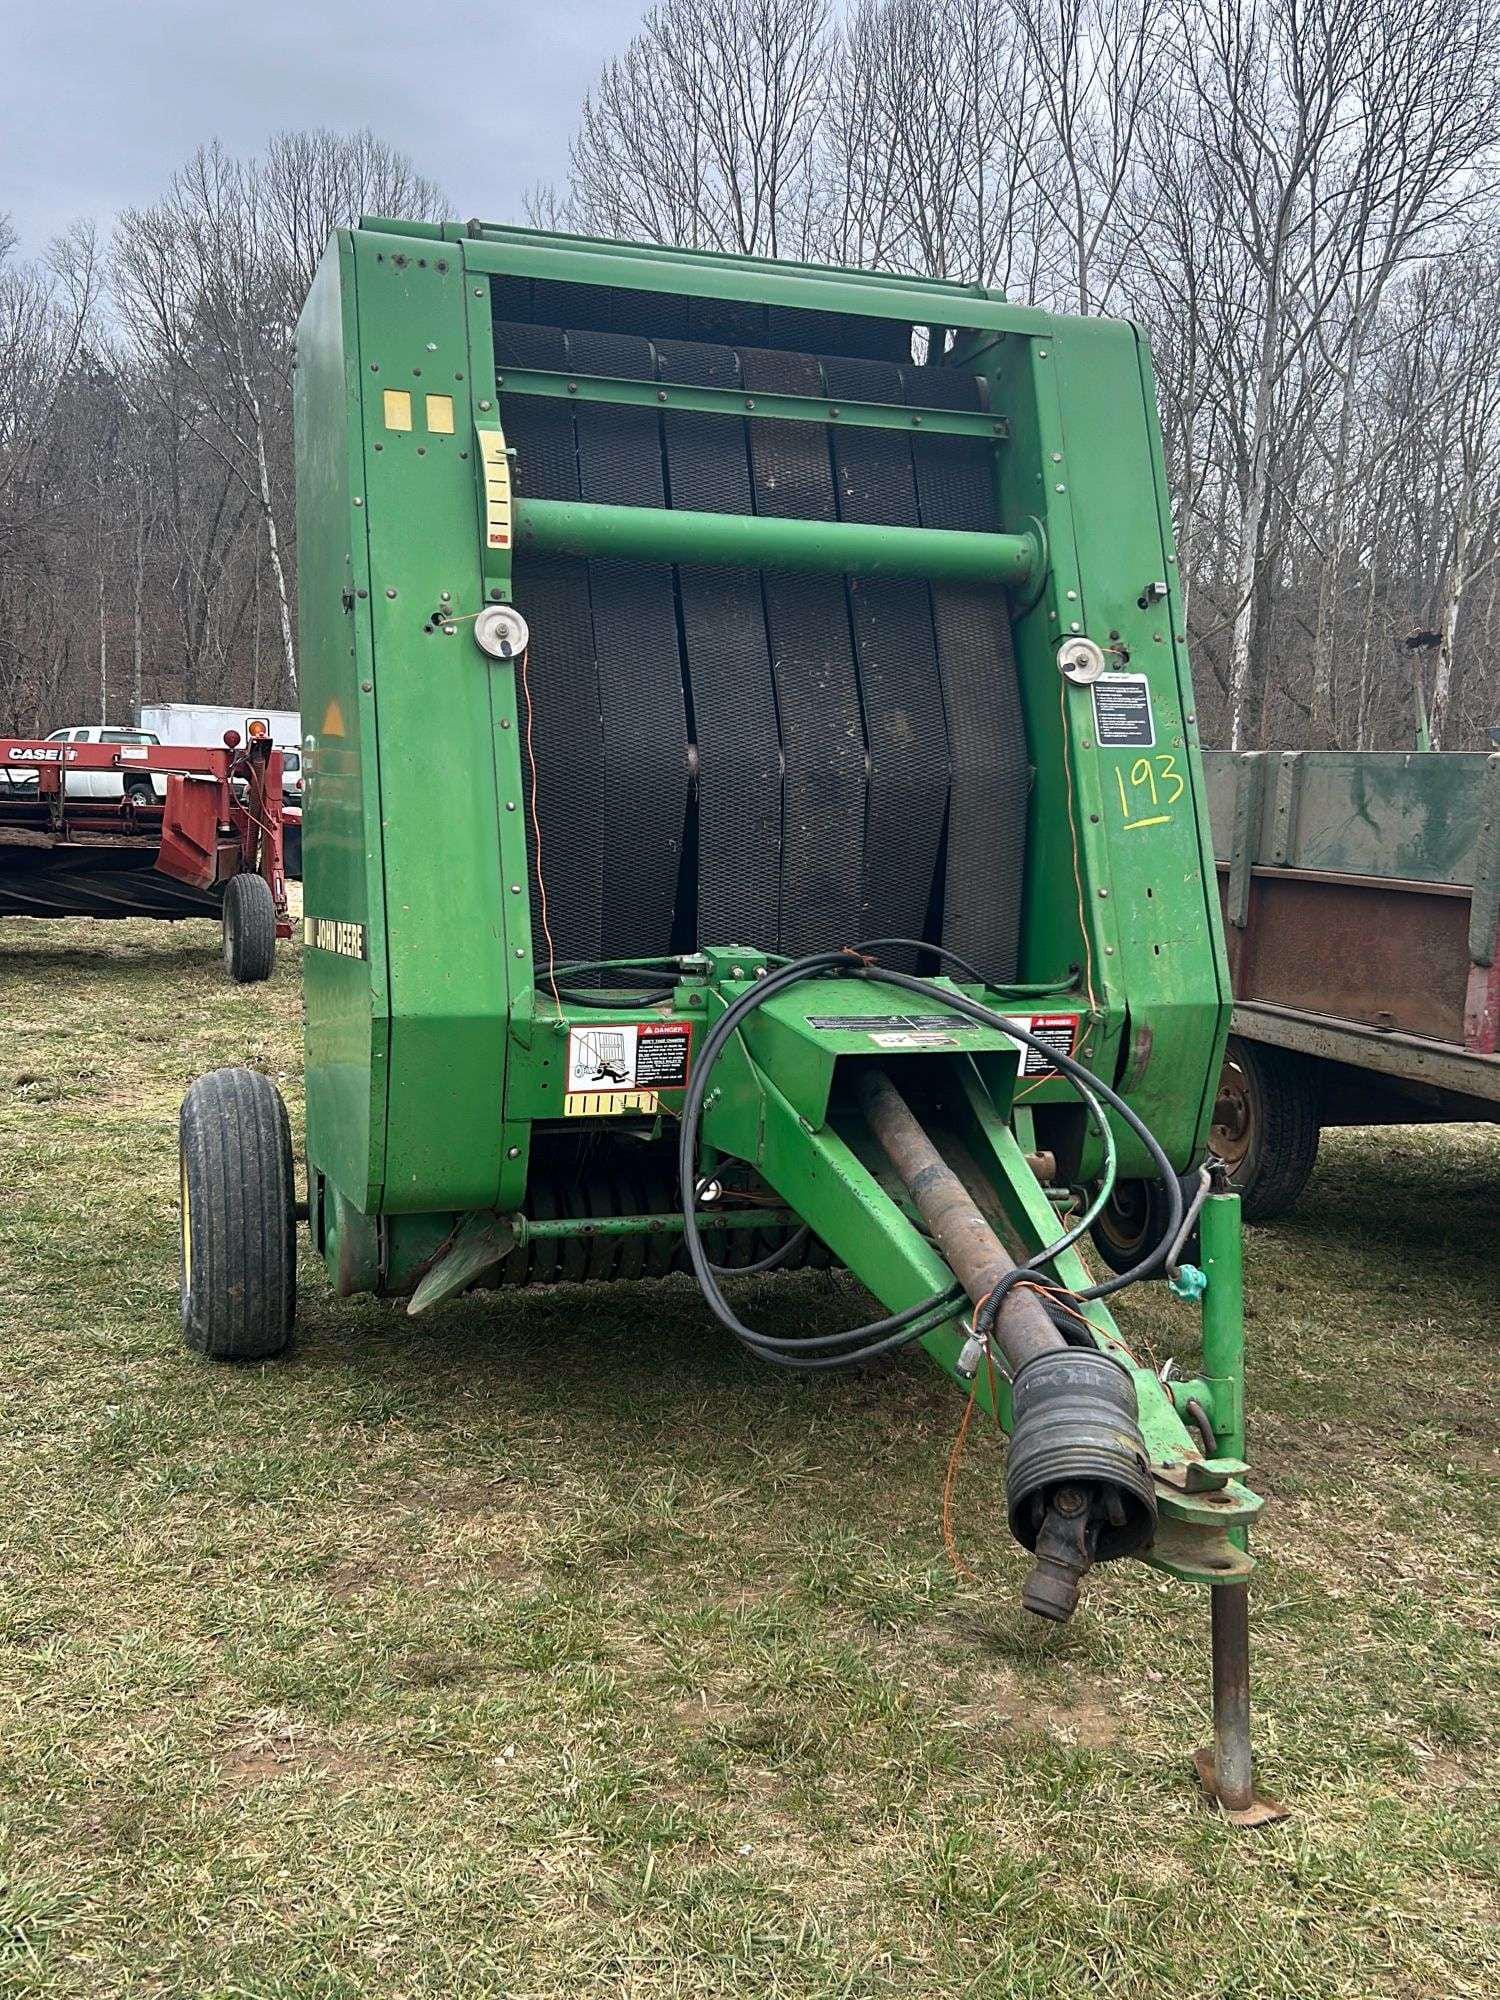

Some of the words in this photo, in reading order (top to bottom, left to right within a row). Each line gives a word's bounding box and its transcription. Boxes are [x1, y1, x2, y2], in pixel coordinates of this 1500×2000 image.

[8, 748, 59, 761] CASE
[1115, 754, 1184, 817] 193
[316, 919, 336, 952] JOHN
[337, 922, 362, 959] DEERE
[653, 1026, 683, 1035] DANGER
